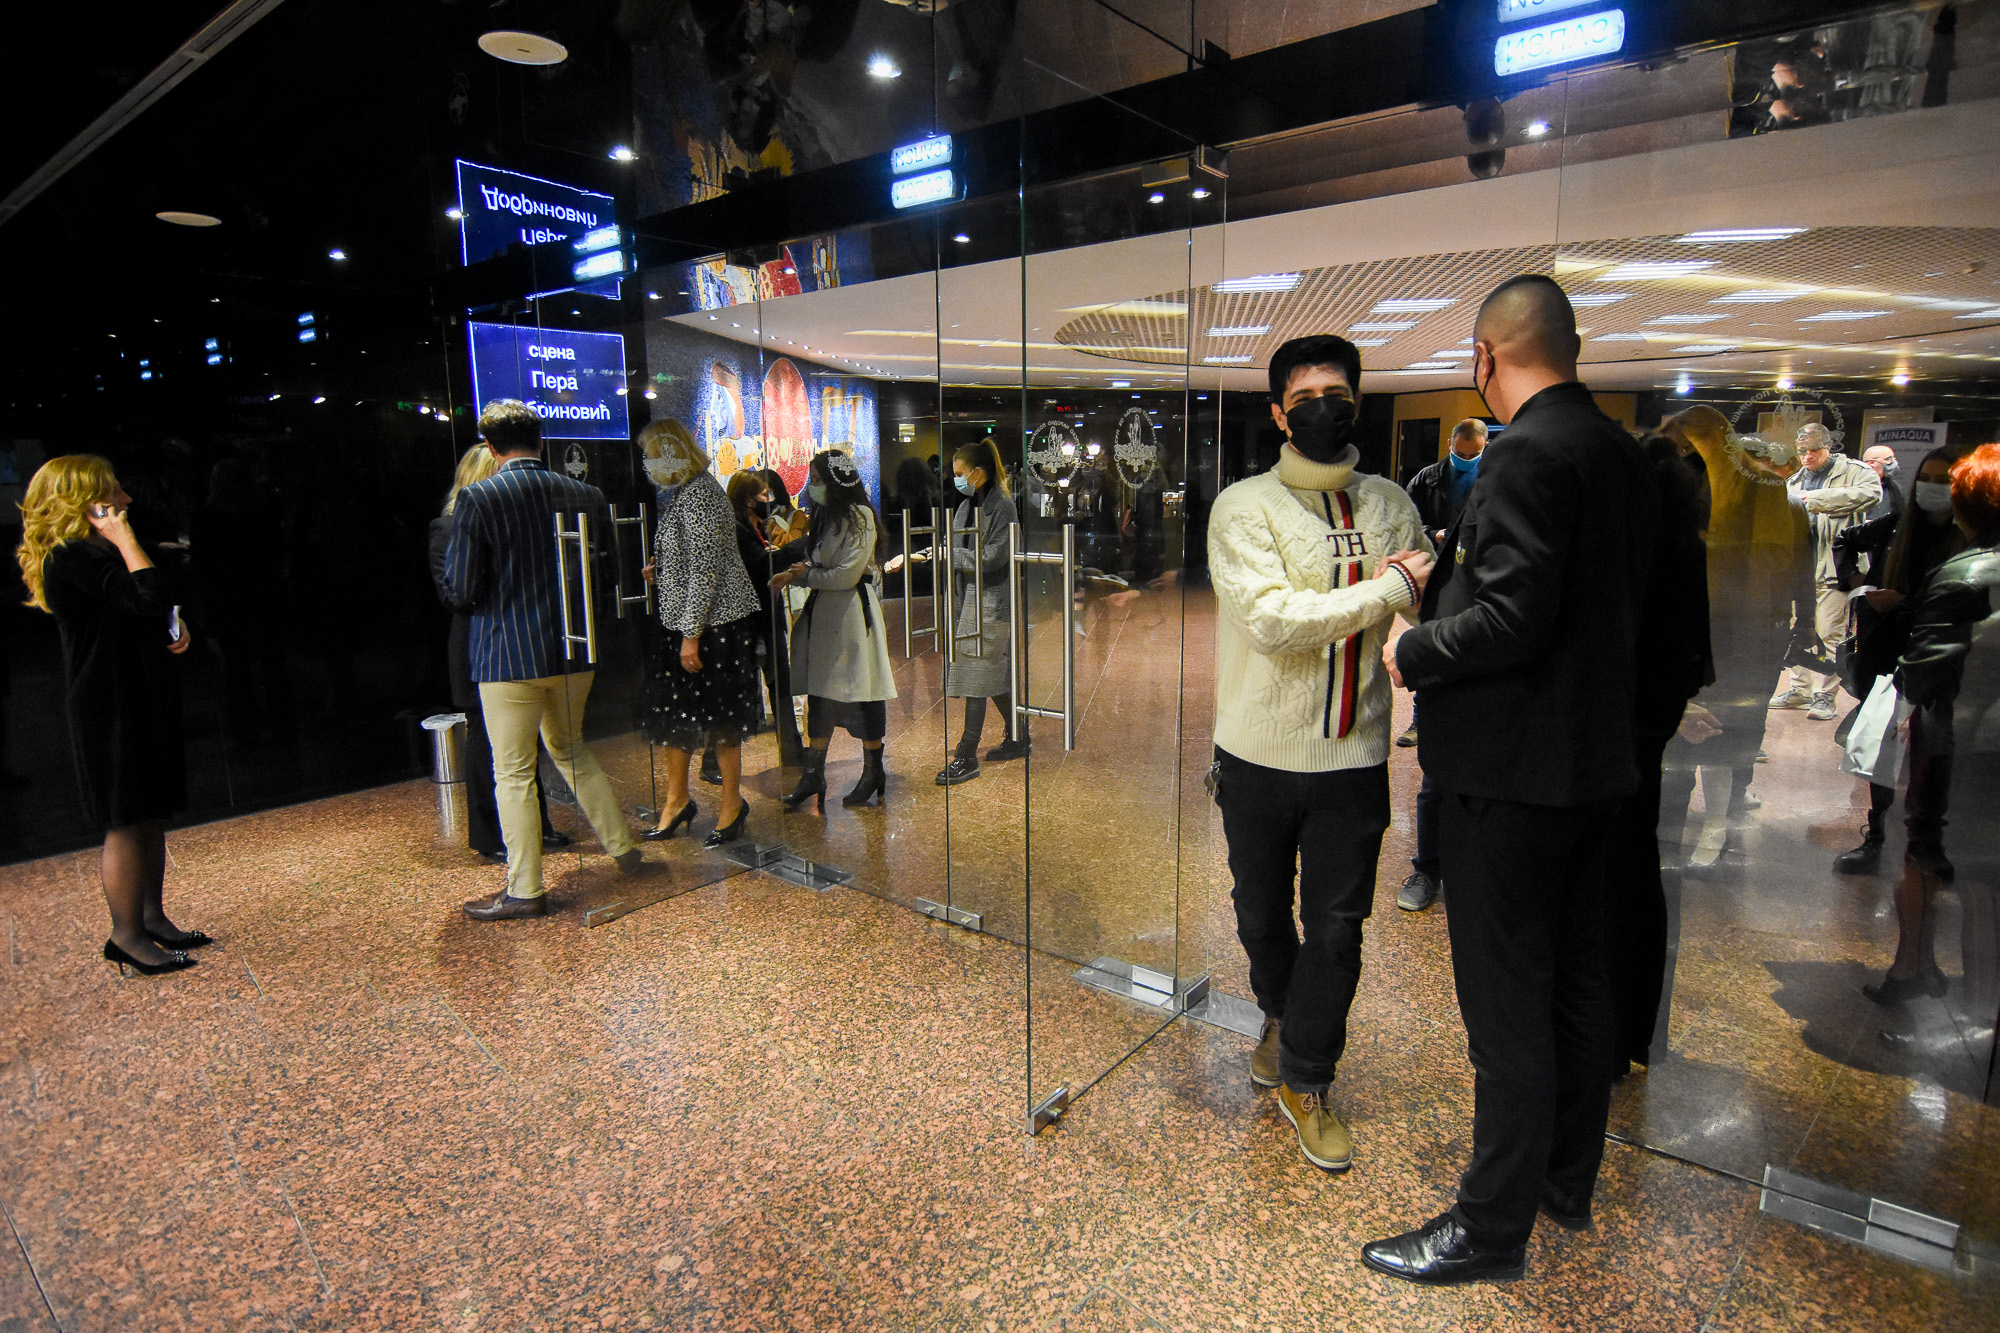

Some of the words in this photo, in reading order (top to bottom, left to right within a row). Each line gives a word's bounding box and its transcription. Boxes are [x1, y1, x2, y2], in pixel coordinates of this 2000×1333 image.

[1505, 18, 1609, 63] ИЗЛАЗ
[528, 345, 576, 361] сцена
[531, 370, 579, 393] Пера
[1878, 430, 1931, 442] MINAQUA
[1326, 532, 1369, 558] TH
